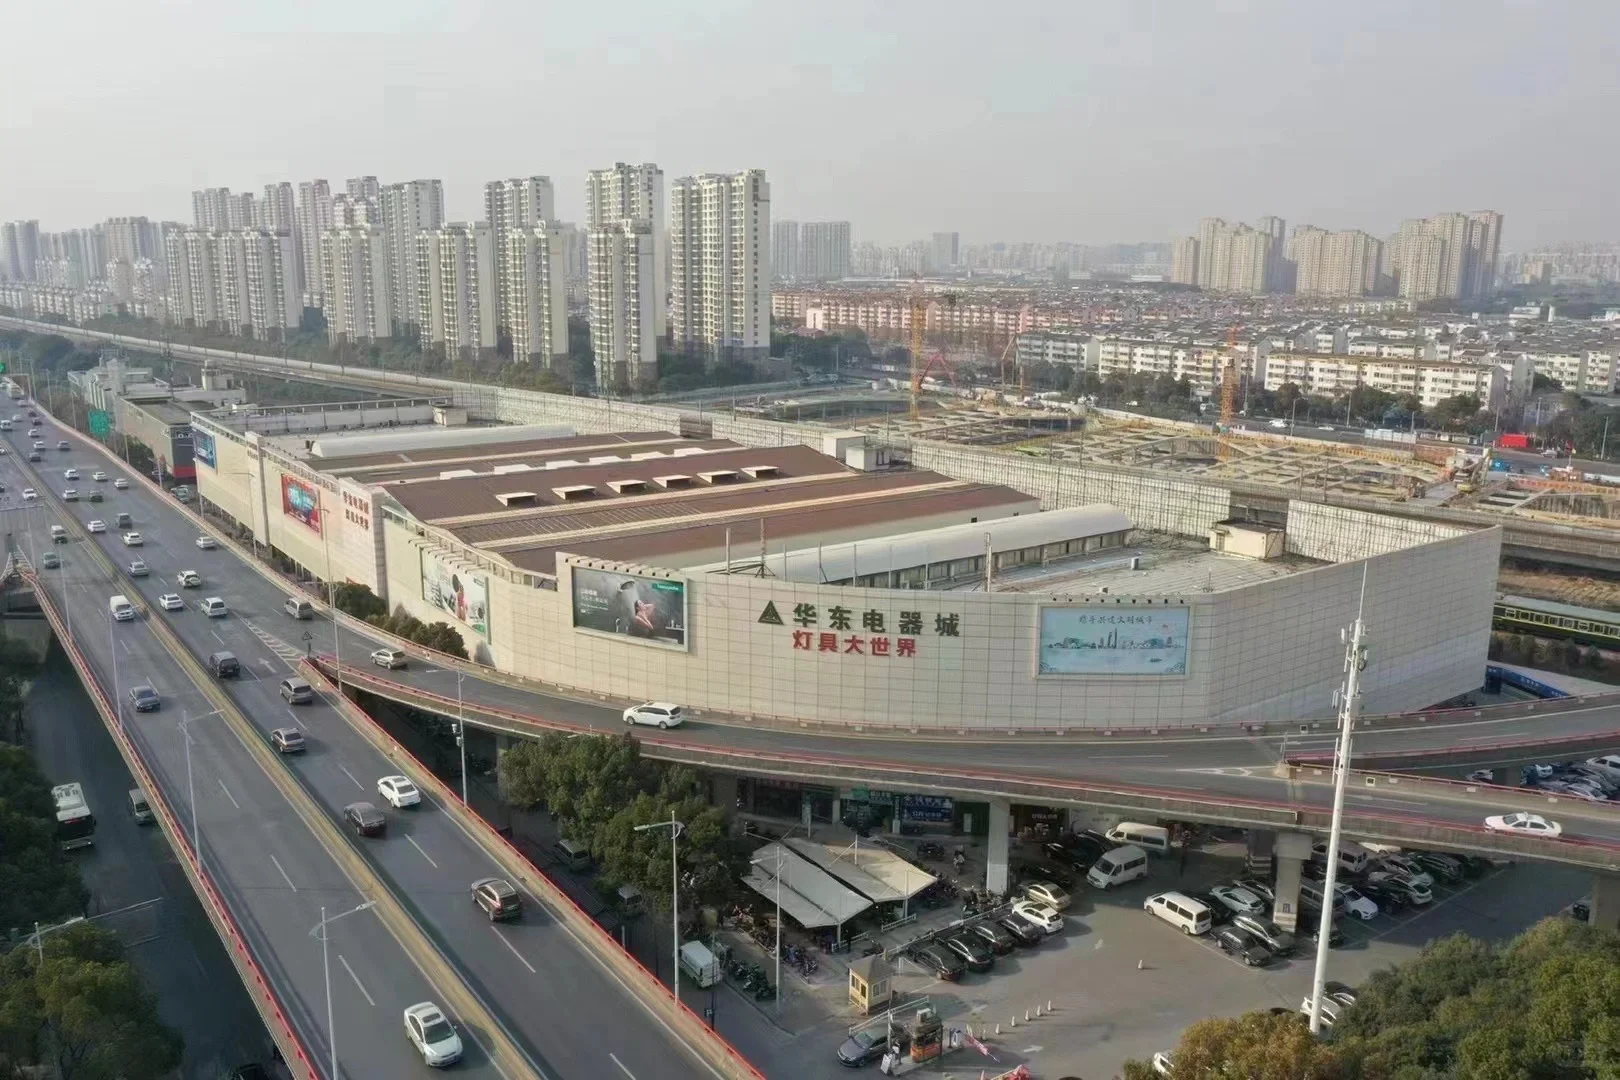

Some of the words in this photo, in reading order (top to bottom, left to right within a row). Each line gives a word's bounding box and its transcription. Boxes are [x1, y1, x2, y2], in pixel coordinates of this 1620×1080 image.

[793, 602, 960, 637] 华东电器城
[792, 629, 918, 658] 灯具大世界
